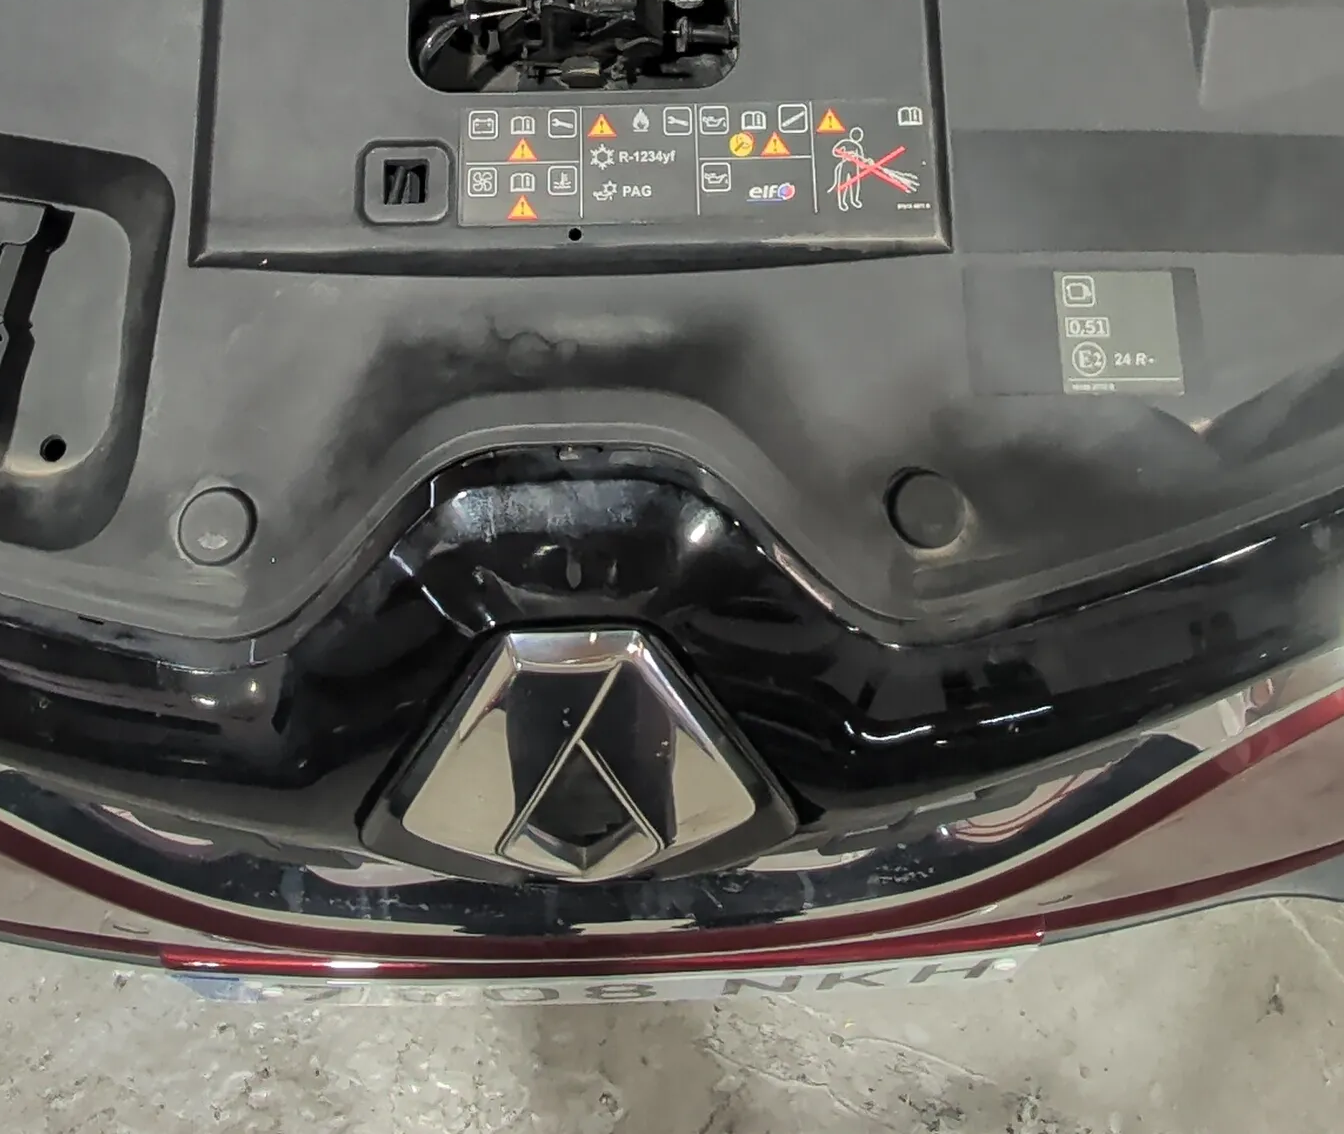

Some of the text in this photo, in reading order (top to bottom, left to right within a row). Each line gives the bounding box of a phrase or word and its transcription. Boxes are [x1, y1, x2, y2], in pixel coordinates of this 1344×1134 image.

[618, 149, 676, 165] R-1234yf
[622, 185, 652, 197] PAG
[748, 184, 779, 199] elf
[1077, 349, 1103, 369] E2
[1114, 352, 1131, 366] 24
[721, 957, 998, 995] NKH
